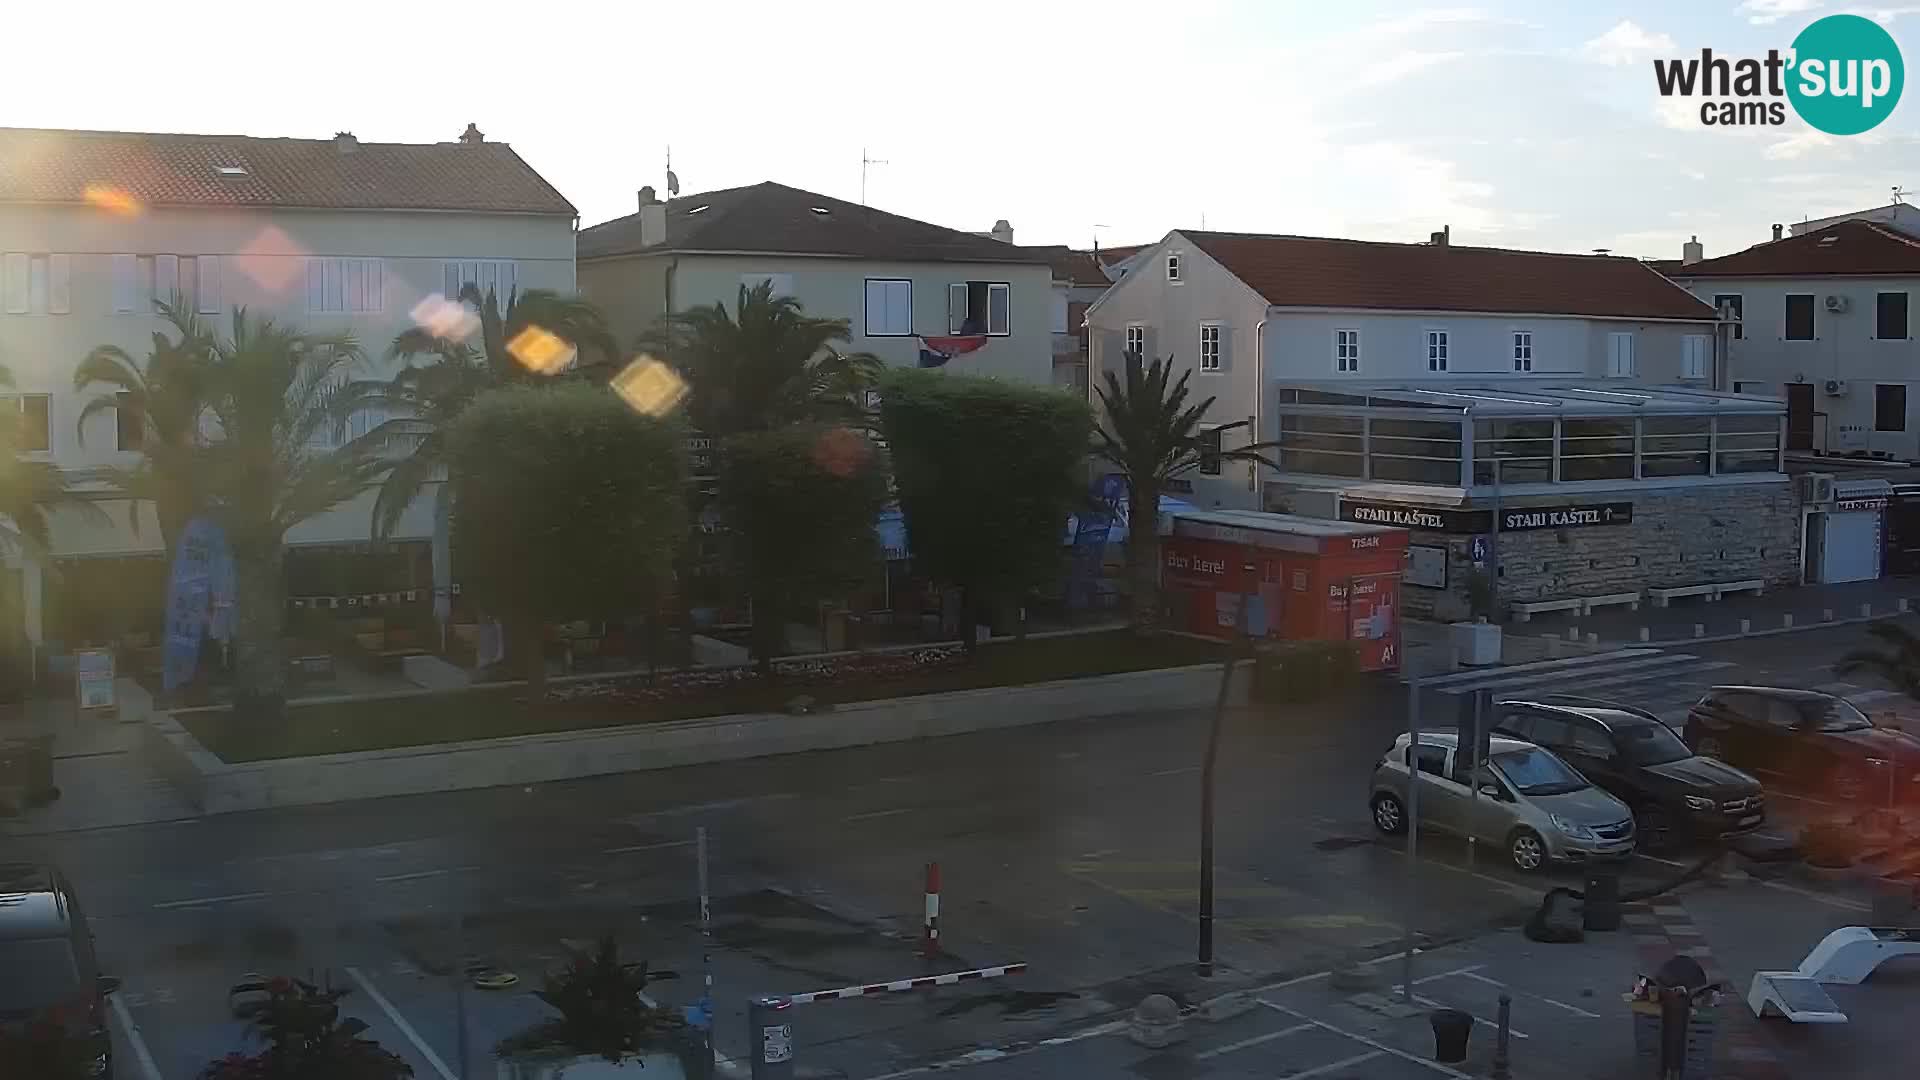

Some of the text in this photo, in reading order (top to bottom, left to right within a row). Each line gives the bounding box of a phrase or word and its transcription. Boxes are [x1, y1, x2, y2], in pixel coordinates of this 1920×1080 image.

[1354, 507, 1444, 528] STARI KAŠTEL
[1506, 507, 1601, 528] STARI KAŠTEL
[1352, 536, 1380, 549] TISAK
[1193, 555, 1226, 575] here!
[1330, 585, 1349, 599] Buy
